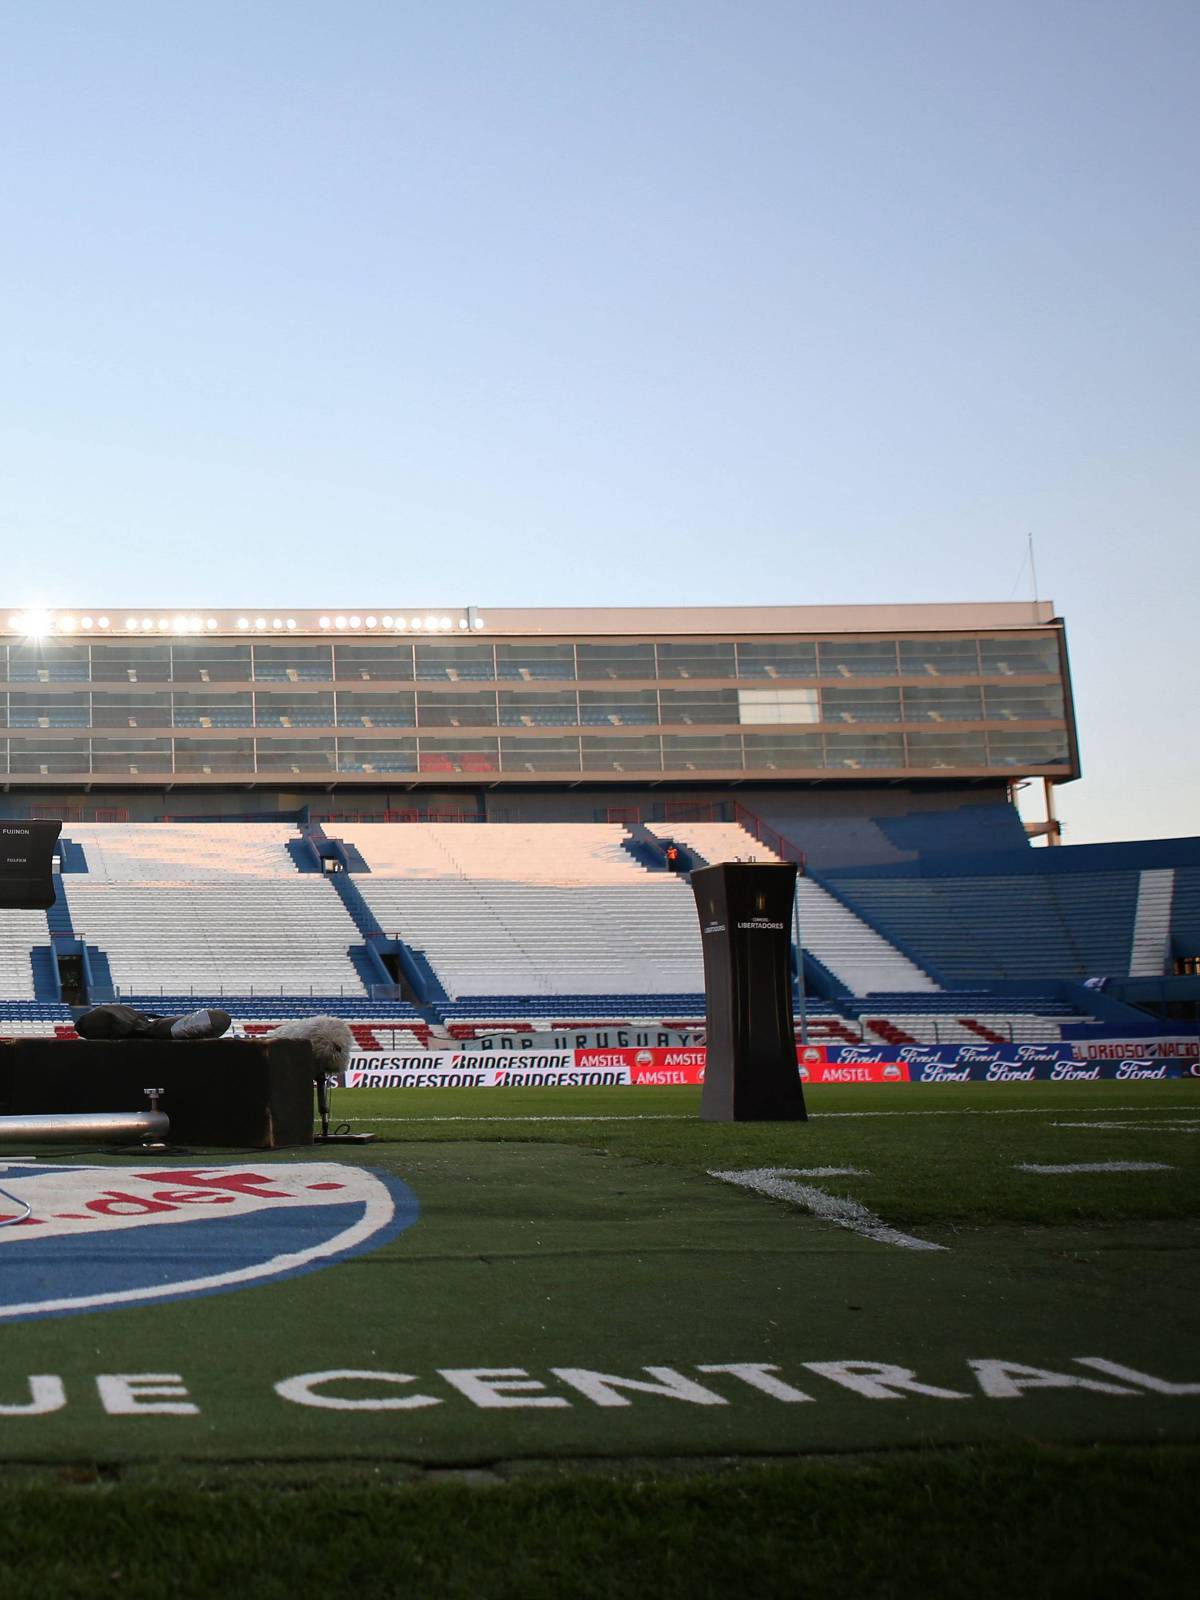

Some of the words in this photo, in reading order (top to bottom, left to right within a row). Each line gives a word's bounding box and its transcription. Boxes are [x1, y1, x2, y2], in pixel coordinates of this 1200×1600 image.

[554, 1031, 689, 1050] URUGUAY
[580, 1055, 627, 1067] AMSTEL
[837, 1047, 882, 1064] Ford
[896, 1046, 941, 1063] Ford
[955, 1046, 1000, 1062] Ford
[1014, 1045, 1059, 1061] Ford
[452, 1055, 571, 1069] BRIDGESTONE
[1116, 1060, 1167, 1080] Ford
[495, 1071, 627, 1086] BRIDGESTONE
[636, 1071, 687, 1084] AMSTEL
[822, 1069, 872, 1082] AMSTEL
[920, 1063, 971, 1082] Ford
[986, 1061, 1036, 1081] Ford
[1050, 1060, 1101, 1081] Ford
[352, 1073, 486, 1088] BRIDGESTONE
[274, 1356, 1200, 1411] CENTRAL
